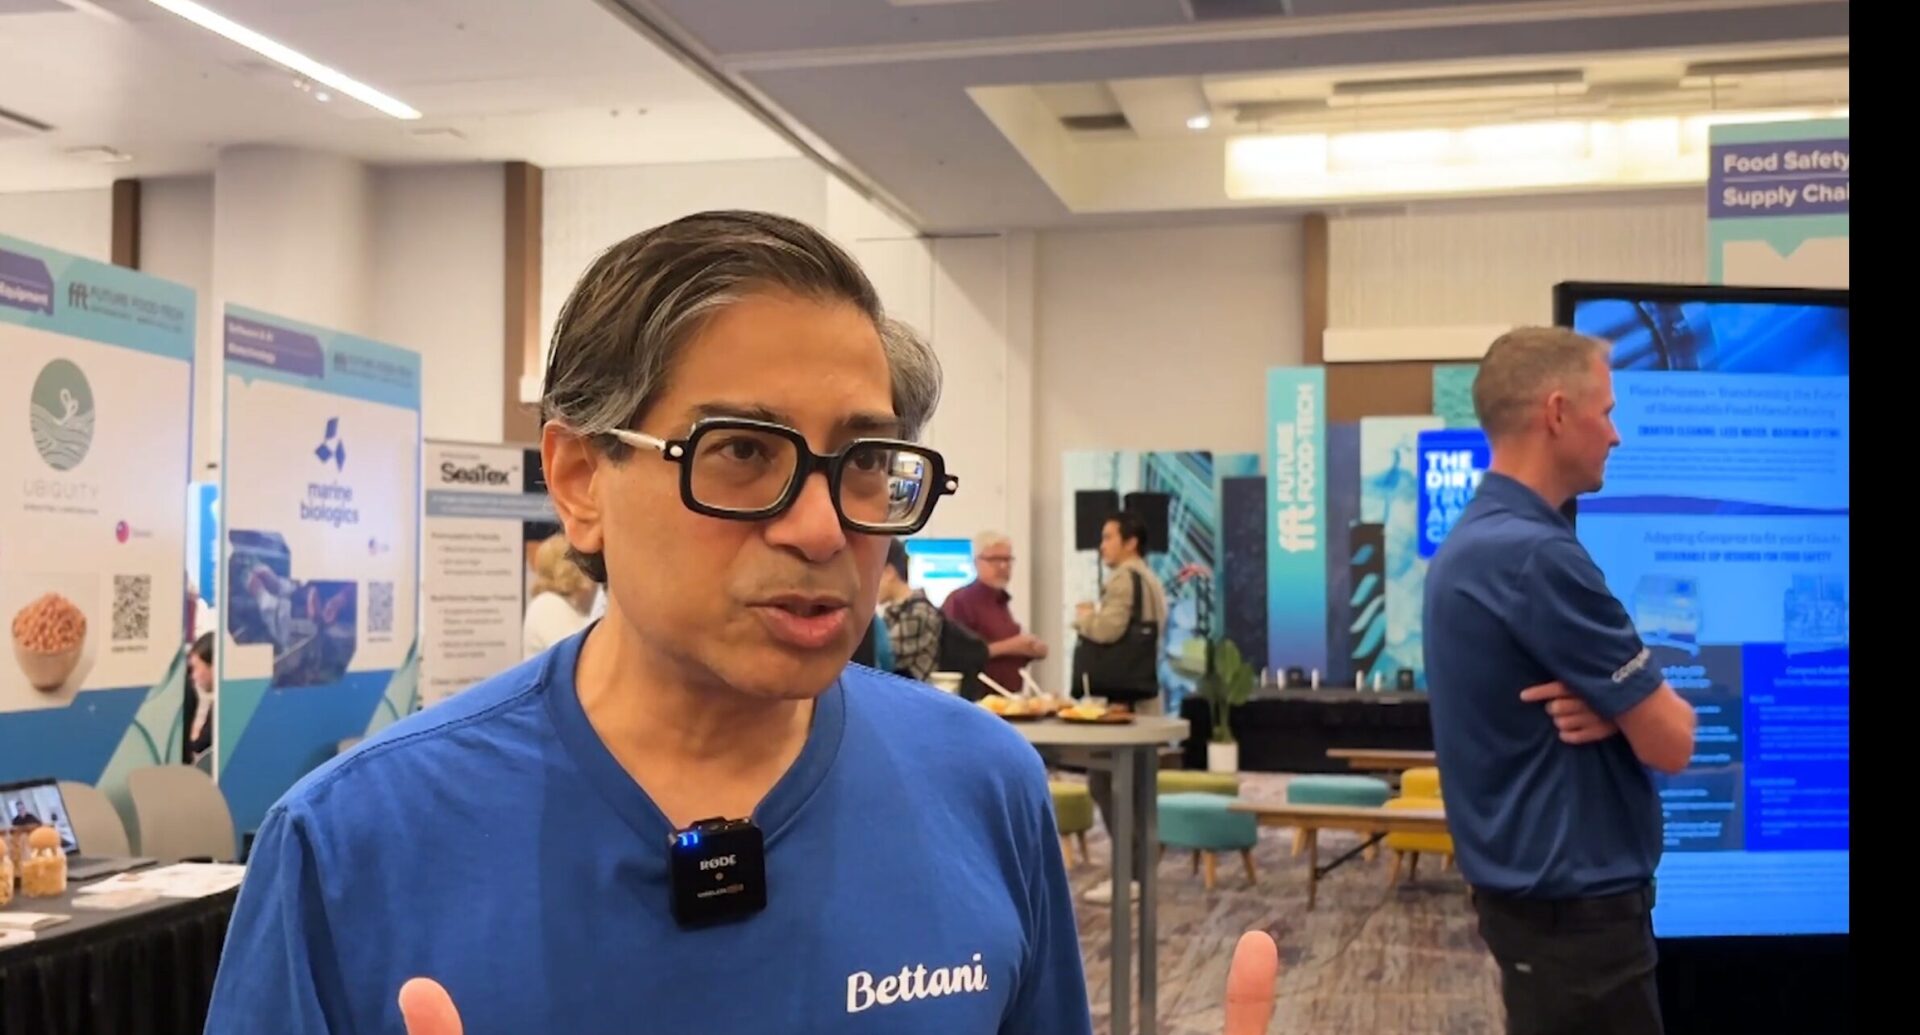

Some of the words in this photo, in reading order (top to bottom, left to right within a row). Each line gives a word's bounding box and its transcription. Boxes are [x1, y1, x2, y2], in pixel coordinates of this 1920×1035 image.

[1723, 152, 1778, 173] Food
[1783, 150, 1849, 172] Safety
[1722, 185, 1798, 209] Supply
[1424, 450, 1473, 470] THE
[440, 462, 510, 486] SeaTex
[307, 481, 353, 501] marine
[300, 502, 359, 528] biologics
[847, 953, 987, 1013] Bettani
